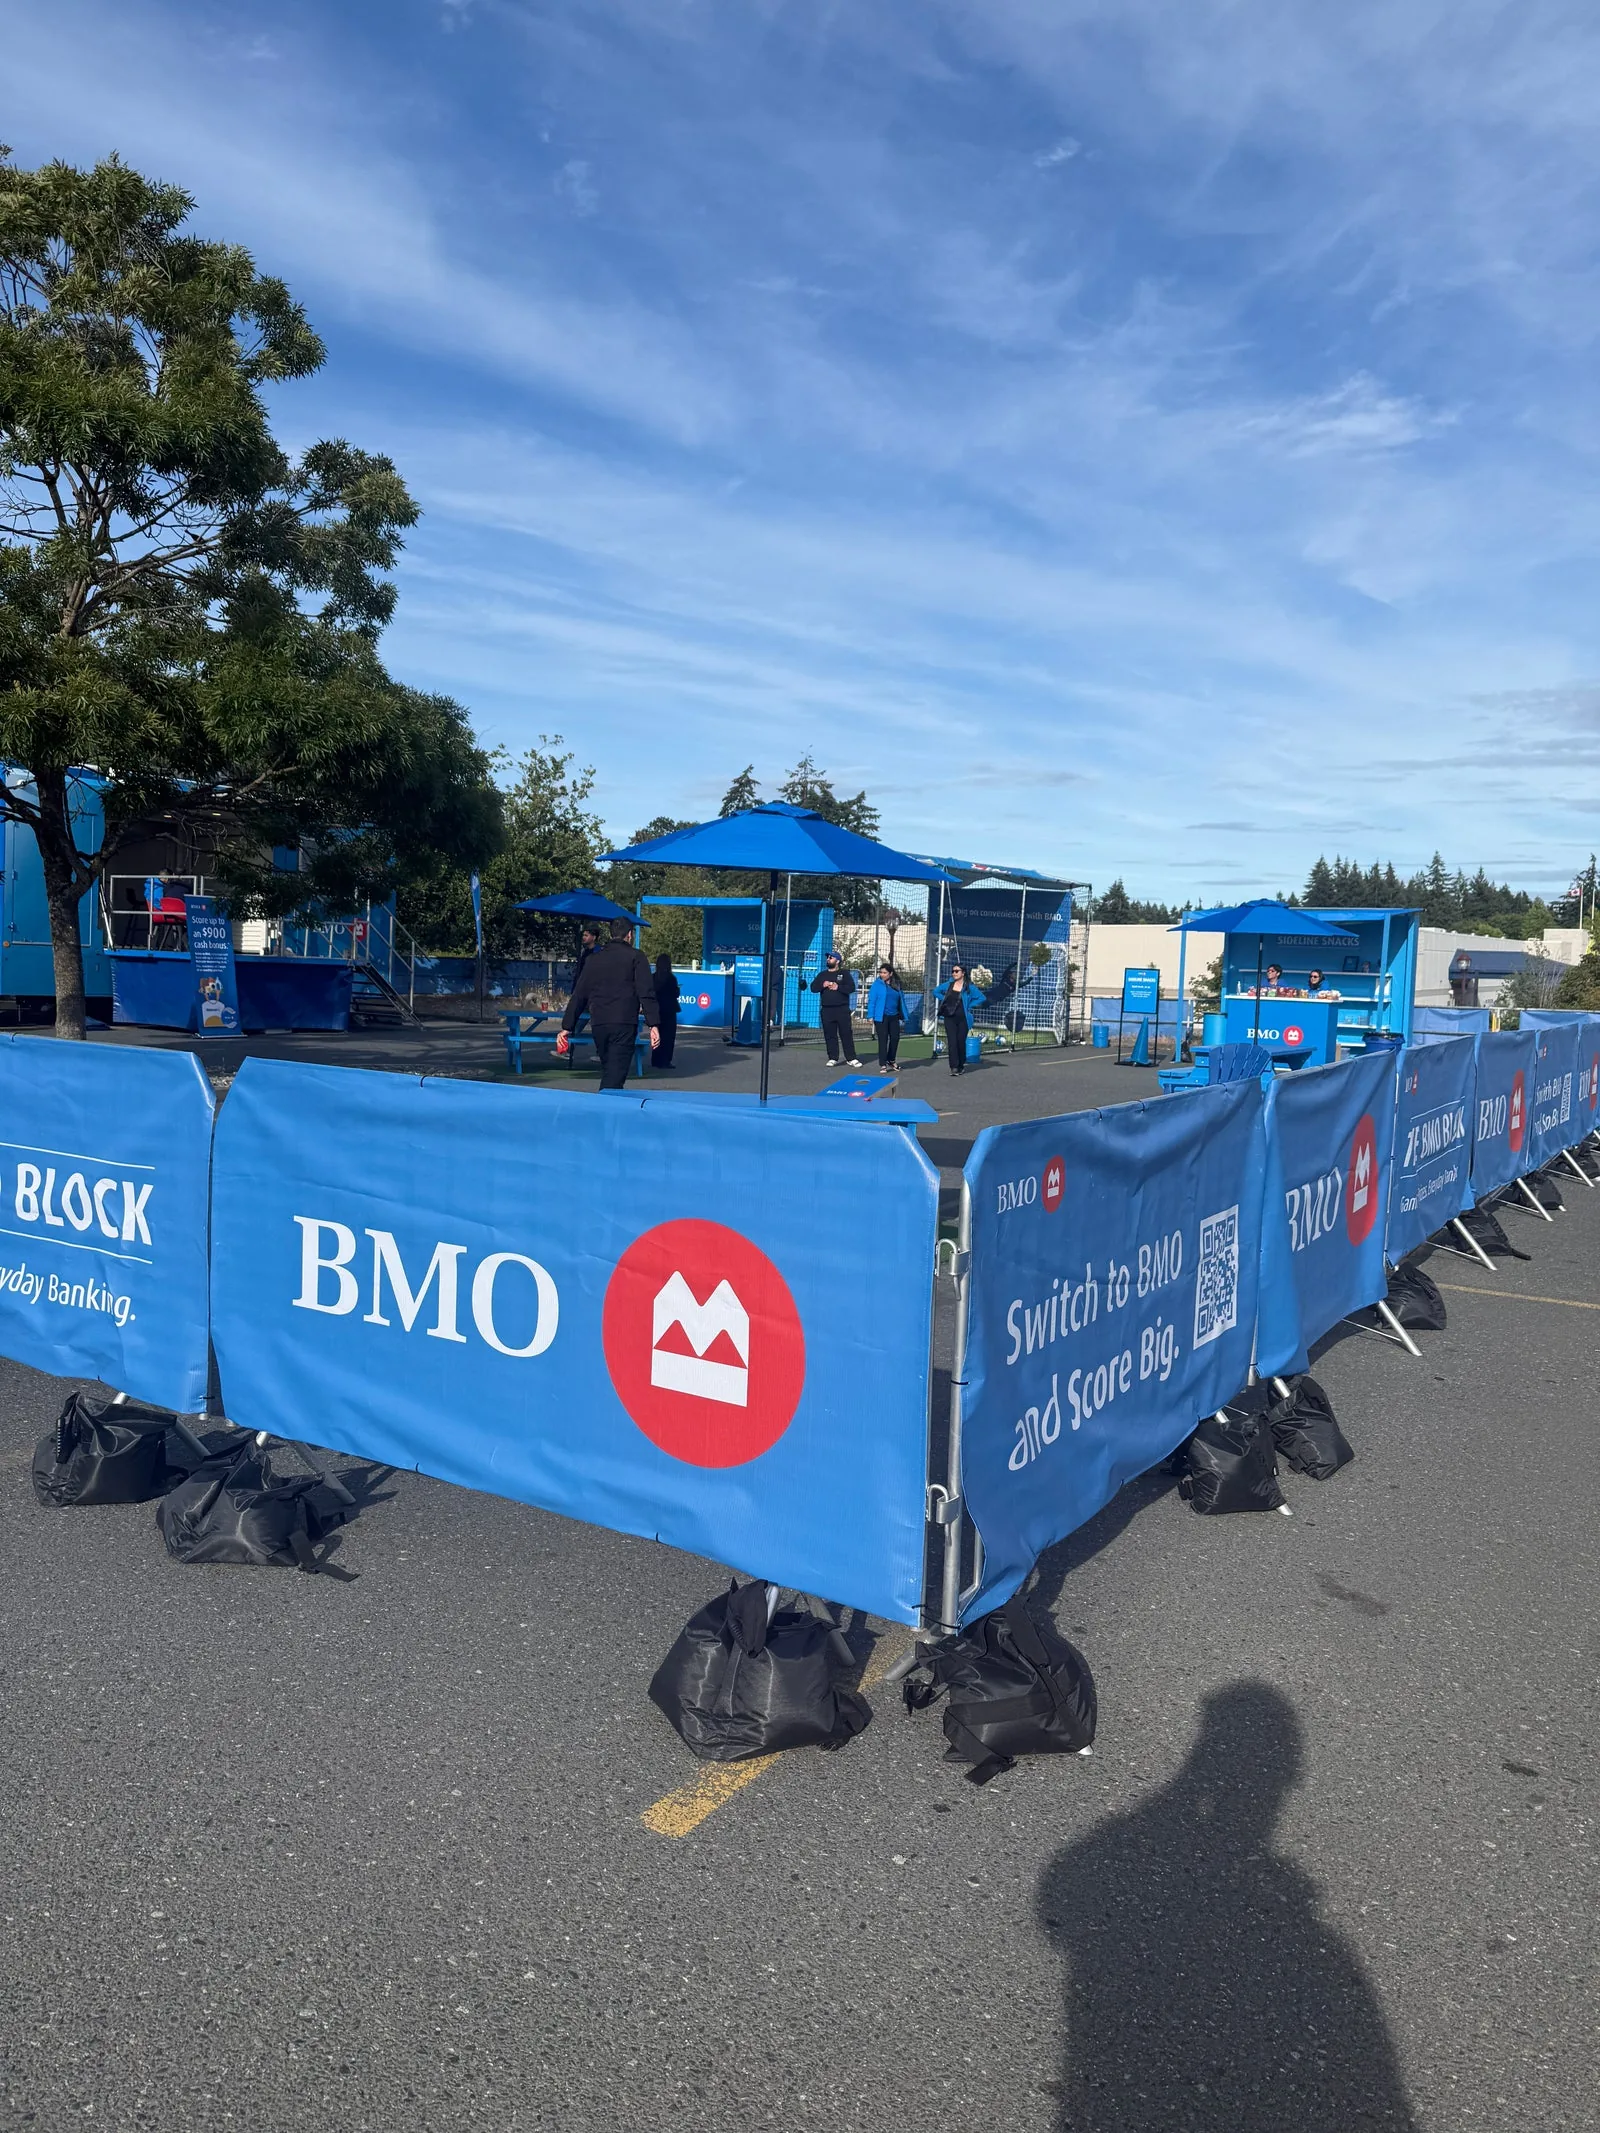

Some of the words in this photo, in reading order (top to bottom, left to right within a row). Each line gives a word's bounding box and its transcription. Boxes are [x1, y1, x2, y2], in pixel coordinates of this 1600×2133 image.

[192, 915, 208, 924] Score
[202, 927, 226, 939] $900
[957, 908, 968, 917] big
[981, 910, 1024, 919] convenienc
[1045, 913, 1063, 921] BMO.
[194, 940, 207, 949] cash
[1277, 935, 1319, 945] SIDELINE
[1322, 936, 1360, 946] SNACKS
[1246, 1028, 1280, 1040] BMO
[1420, 1117, 1441, 1159] BMO
[1478, 1094, 1507, 1142] BMO
[15, 1162, 154, 1246] BLOCK
[997, 1175, 1037, 1215] BMO
[1285, 1166, 1343, 1253] BMO
[0, 1262, 44, 1305] yday
[48, 1274, 136, 1327] Banking.
[292, 1215, 560, 1358] BMO
[1006, 1262, 1098, 1366] Switch
[1107, 1258, 1130, 1313] to
[1137, 1230, 1182, 1298] BMO
[1008, 1373, 1061, 1471] and
[1067, 1348, 1132, 1431] Score
[1139, 1316, 1180, 1381] Big.
